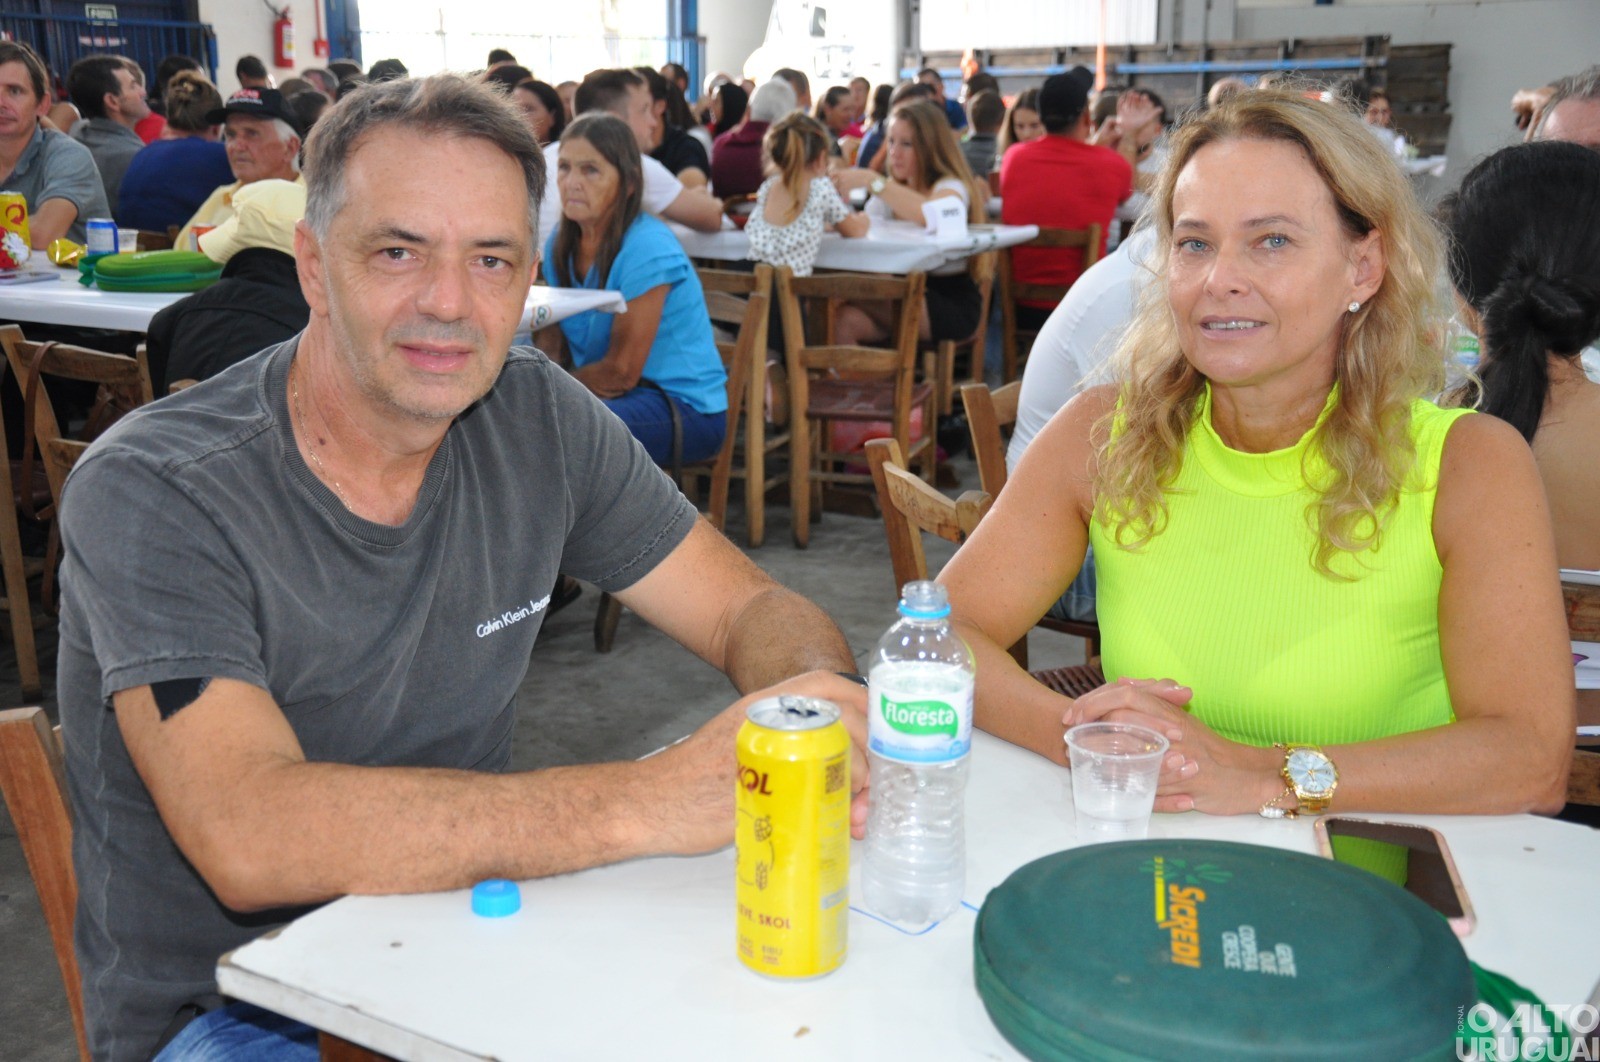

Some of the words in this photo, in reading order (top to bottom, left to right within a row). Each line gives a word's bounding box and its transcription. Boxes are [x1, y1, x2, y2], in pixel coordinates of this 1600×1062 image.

[476, 618, 504, 637] Calvin
[502, 606, 530, 626] Klein
[885, 702, 955, 727] floresta
[758, 912, 792, 931] SKOL
[1161, 884, 1206, 968] SICREDI
